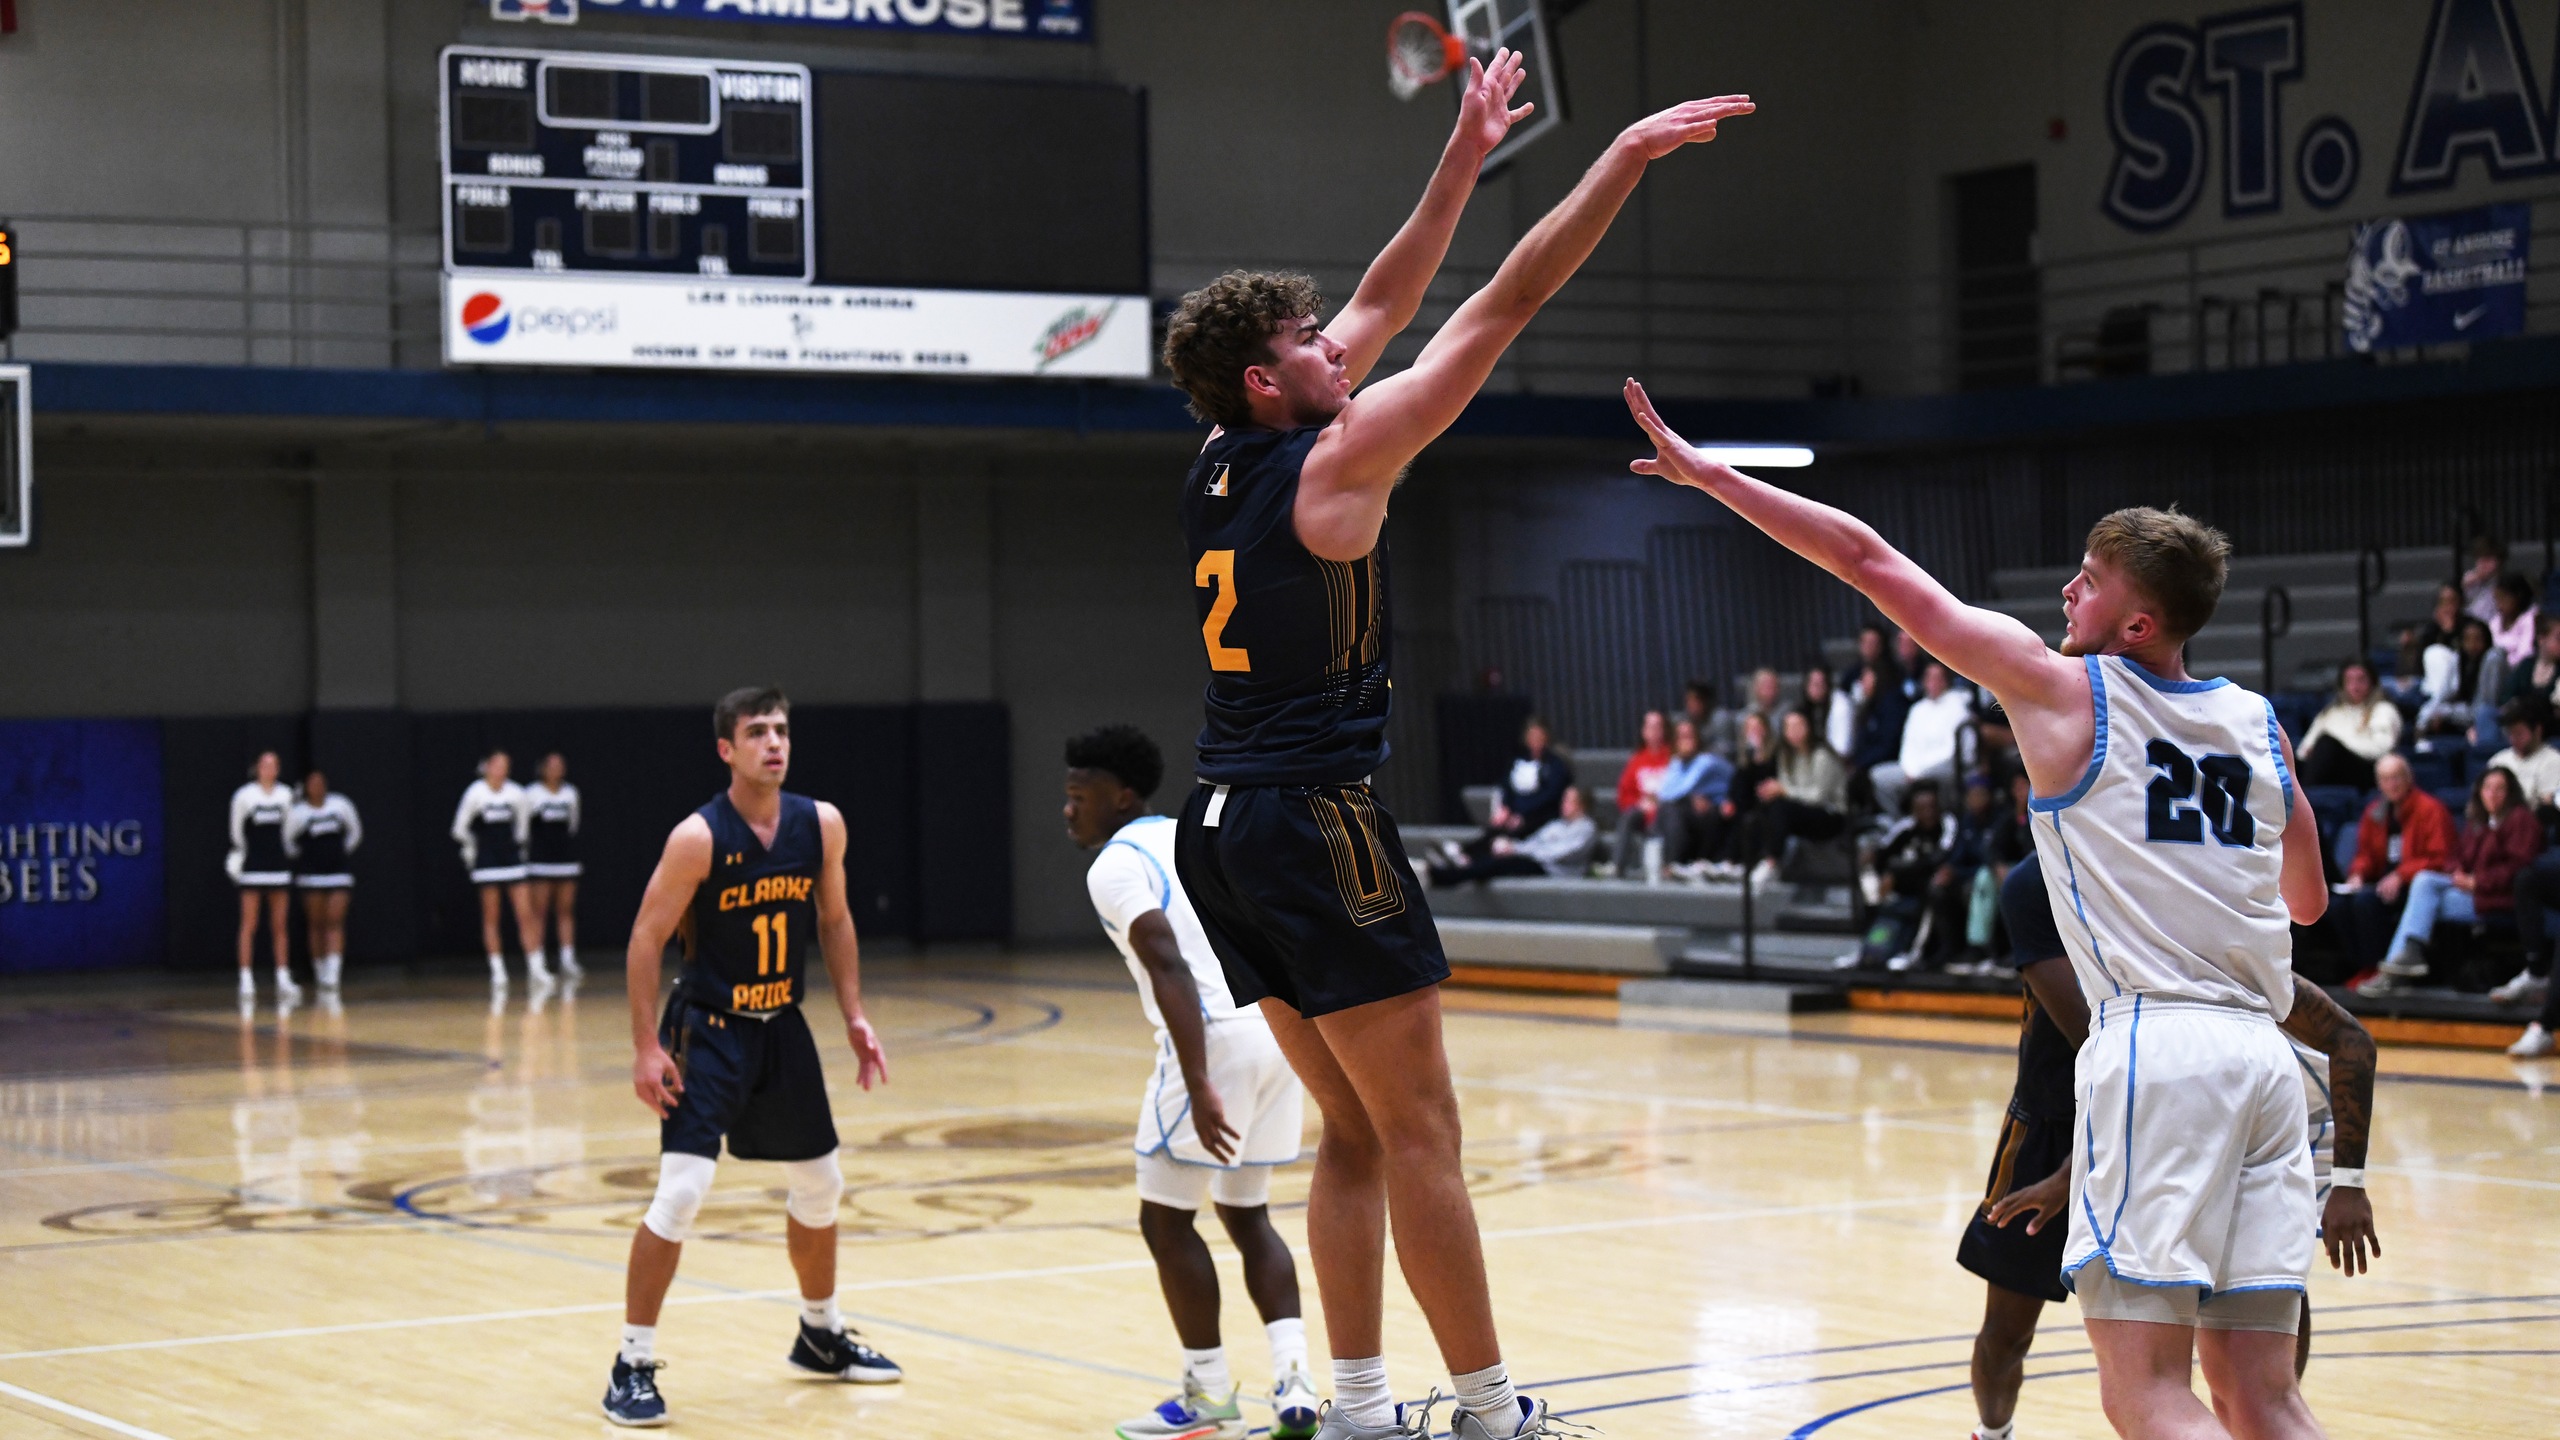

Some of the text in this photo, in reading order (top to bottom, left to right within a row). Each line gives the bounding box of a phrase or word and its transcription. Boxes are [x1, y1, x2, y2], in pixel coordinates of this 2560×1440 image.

[459, 58, 528, 89] HOME
[718, 72, 800, 103] VISITOR
[2101, 0, 2560, 234] ST. A
[487, 153, 545, 177] BONUS
[713, 163, 770, 187] BONUS
[456, 184, 511, 208] FOULS
[574, 189, 638, 213] PLAYER
[648, 194, 701, 216] FOULS
[747, 198, 799, 219] FOULS
[517, 304, 617, 340] pepsi
[1195, 549, 1251, 673] 2
[2144, 738, 2256, 849] 20
[0, 819, 143, 858] HTING
[719, 875, 813, 912] CLARKE
[752, 911, 788, 976] 11
[733, 977, 793, 1012] PRIDE
